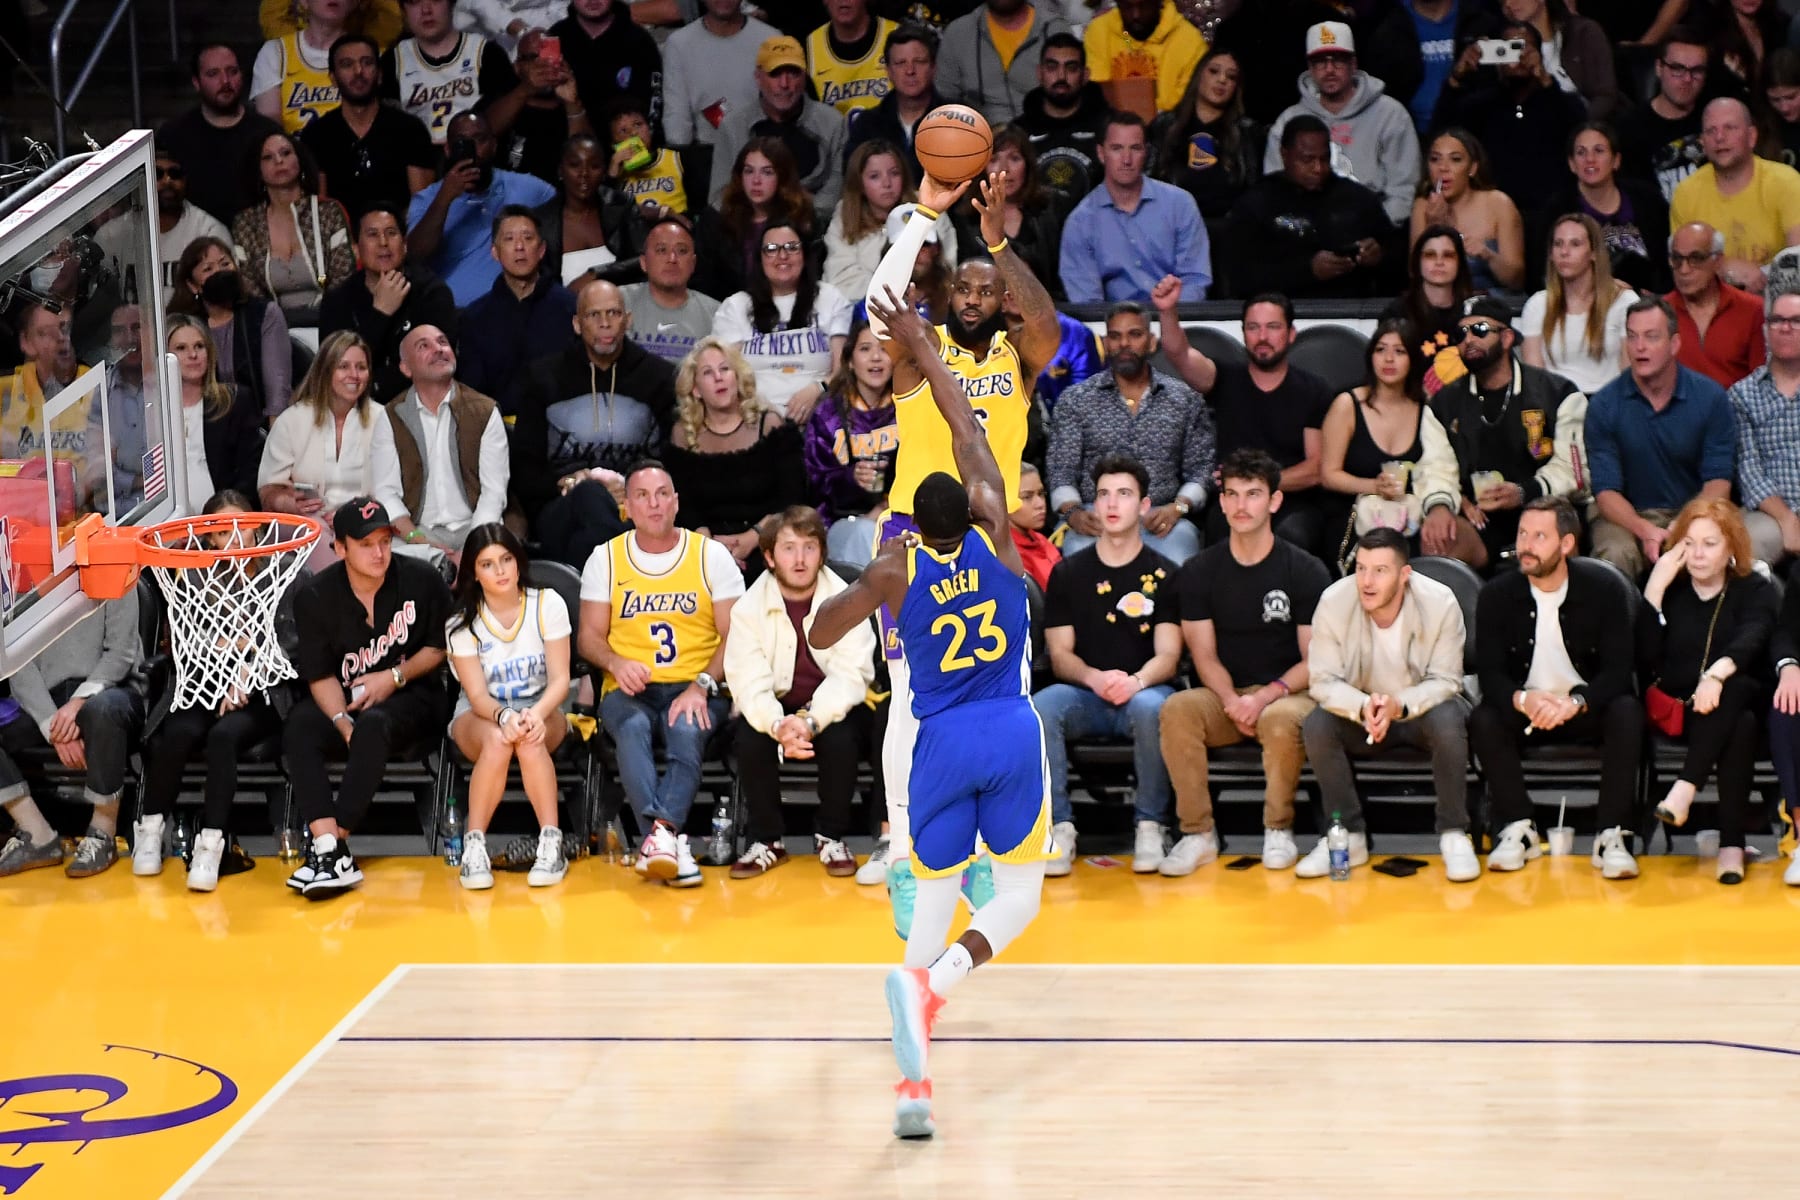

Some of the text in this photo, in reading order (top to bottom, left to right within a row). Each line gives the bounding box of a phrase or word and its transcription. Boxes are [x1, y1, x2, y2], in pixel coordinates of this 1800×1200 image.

[287, 82, 341, 108] LAKE
[405, 77, 475, 108] LAKERS
[822, 78, 890, 105] LAKERS
[624, 175, 675, 195] AKERS
[769, 332, 803, 355] NEXT
[951, 371, 1014, 397] KERS
[929, 568, 979, 605] GREEN
[619, 590, 698, 618] LAKERS
[341, 600, 417, 688] Chicago
[650, 622, 677, 664] 3
[930, 598, 1008, 673] 23
[485, 652, 547, 684] AKERS
